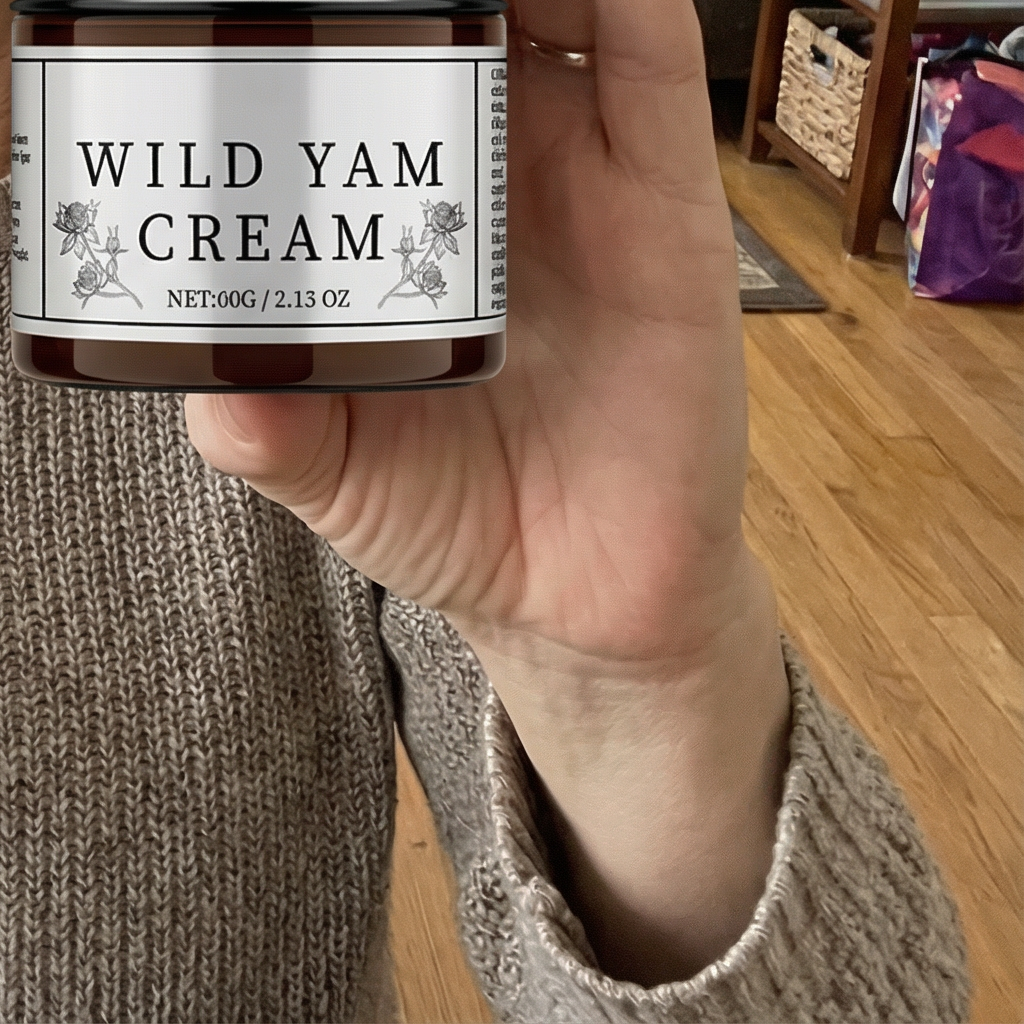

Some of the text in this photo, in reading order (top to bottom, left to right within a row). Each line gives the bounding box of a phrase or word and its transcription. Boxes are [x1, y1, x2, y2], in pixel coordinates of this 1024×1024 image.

[76, 141, 263, 189] WILD
[298, 141, 444, 188] YAM
[138, 213, 384, 262] CREAM
[261, 289, 270, 313] /
[274, 289, 316, 309] 2.13
[322, 289, 350, 308] OZ
